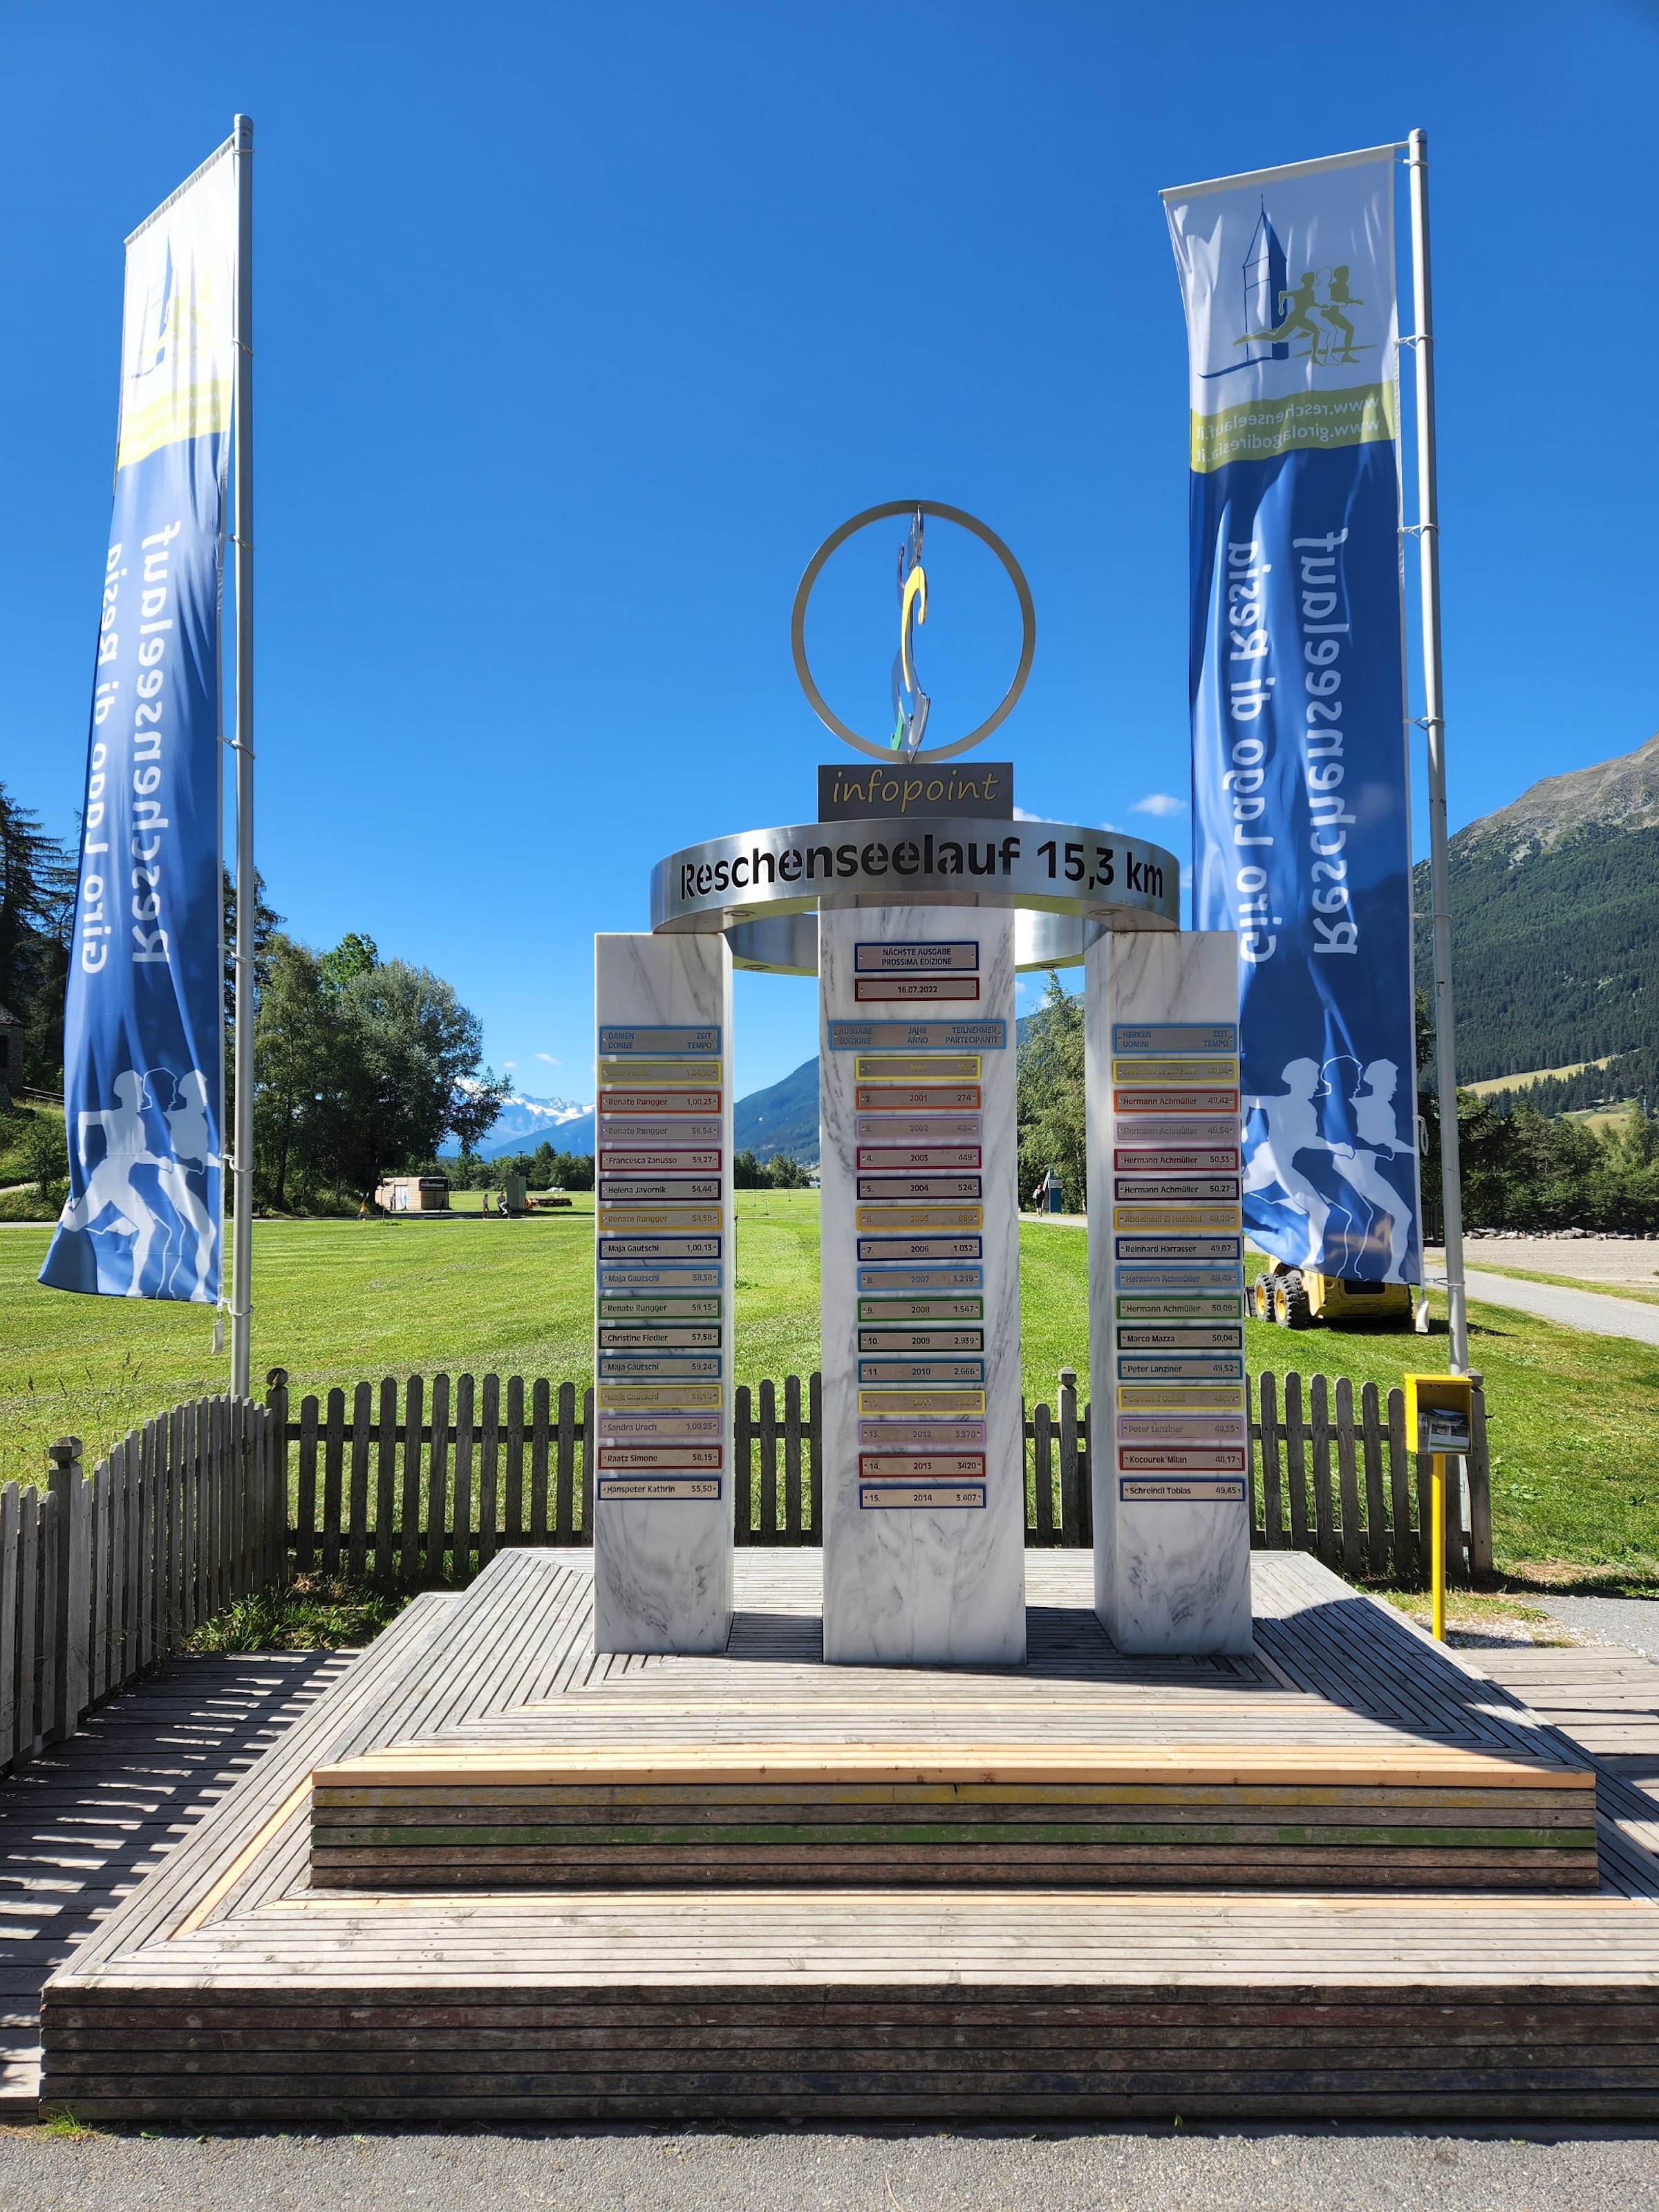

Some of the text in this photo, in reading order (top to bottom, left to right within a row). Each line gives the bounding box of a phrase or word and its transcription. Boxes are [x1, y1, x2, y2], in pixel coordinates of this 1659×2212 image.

[832, 769, 1000, 813] infopoint
[680, 834, 1163, 900] Reschenseelauf 15,3 km
[883, 948, 915, 956] NÄCHSTE
[881, 958, 918, 966] PROSSIMA
[637, 1098, 668, 1107] Rungger
[637, 1127, 668, 1136] Rungger
[637, 1215, 668, 1224] Rungger
[692, 1215, 712, 1223] 54,58
[686, 1244, 712, 1253] 1,00,13
[608, 1275, 626, 1283] Maja
[1213, 1365, 1233, 1373] 49,52
[686, 1423, 712, 1431] 1,00,25
[693, 1454, 712, 1462] 58,15
[1215, 1456, 1236, 1464] 48,17
[607, 1485, 646, 1494] Hanspeter
[1215, 1487, 1237, 1495] 49,45
